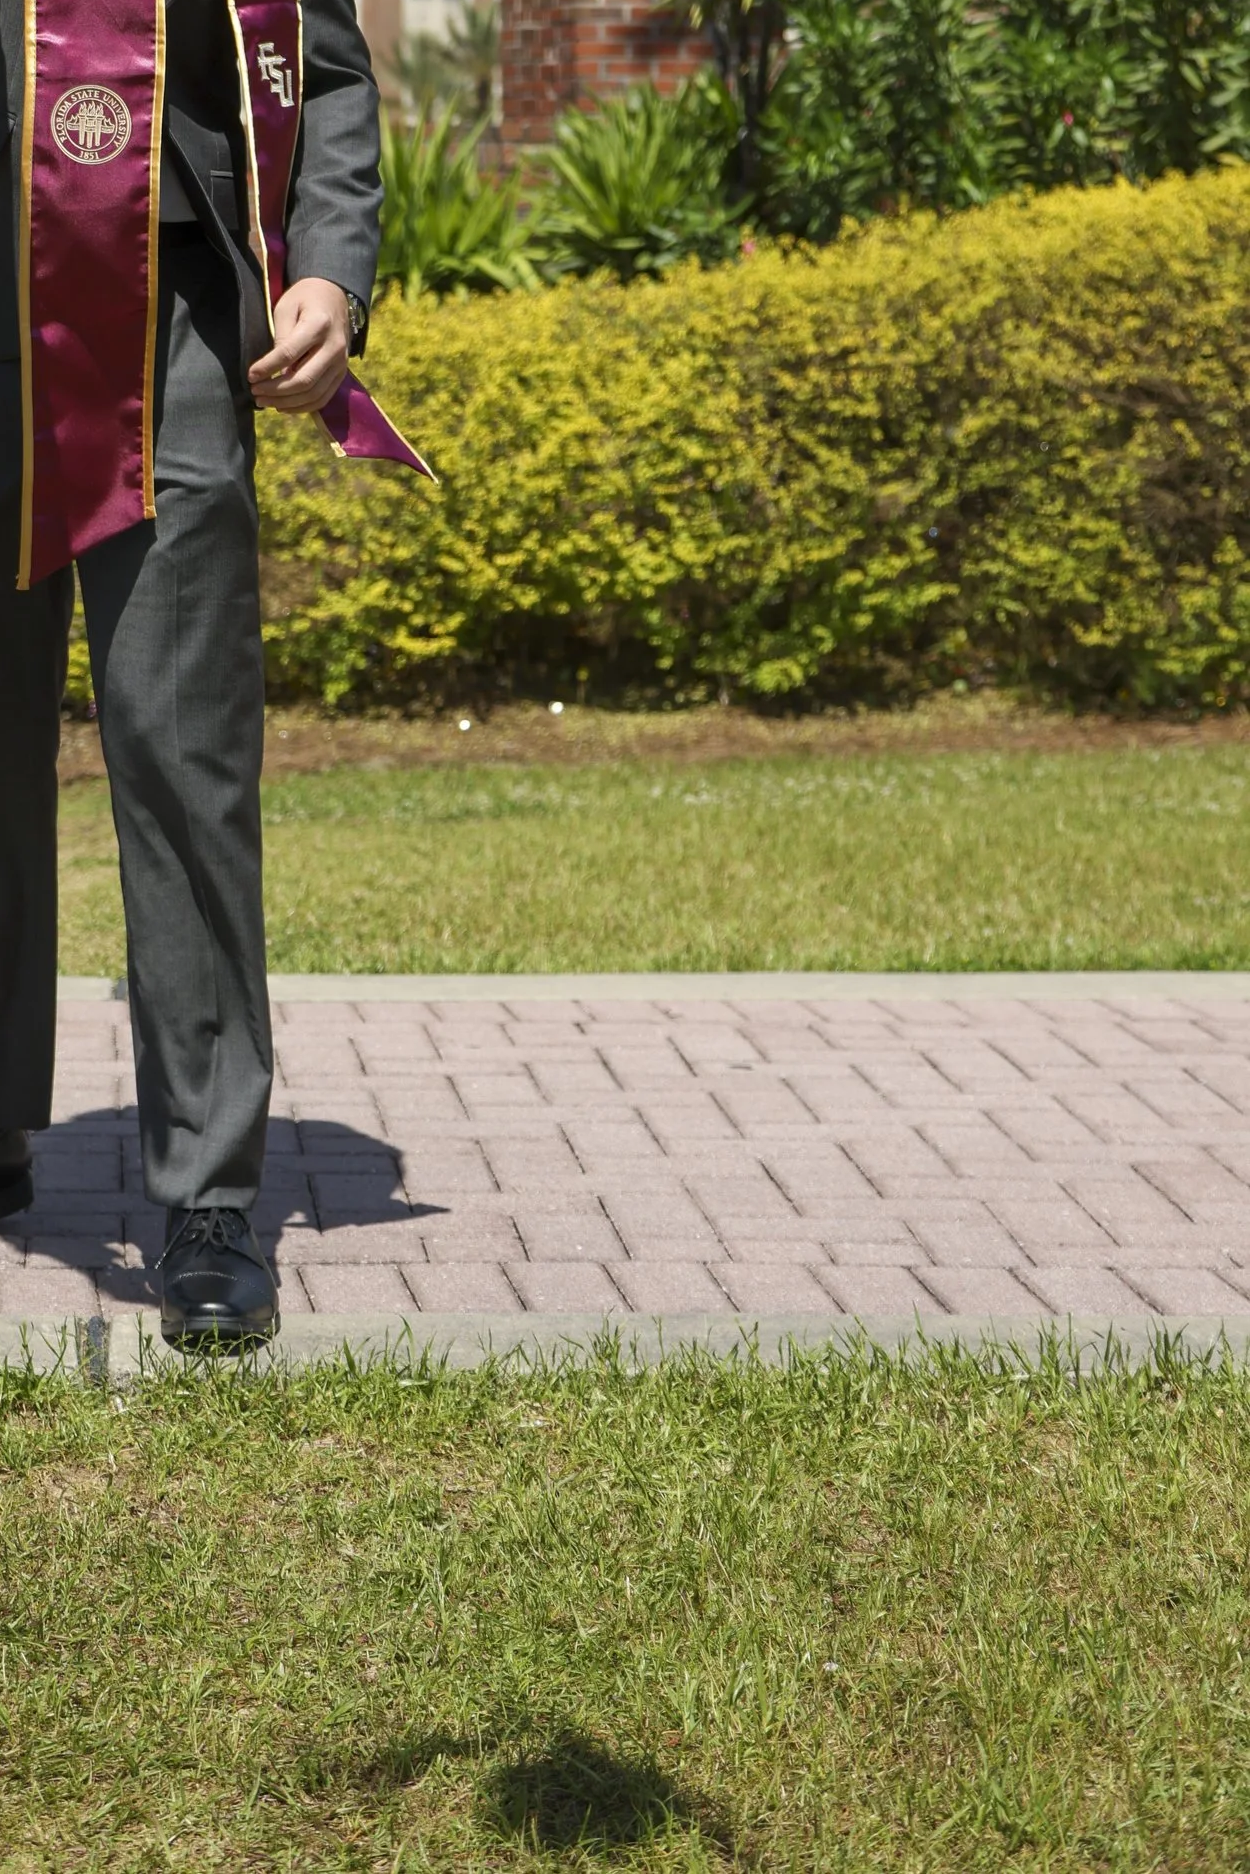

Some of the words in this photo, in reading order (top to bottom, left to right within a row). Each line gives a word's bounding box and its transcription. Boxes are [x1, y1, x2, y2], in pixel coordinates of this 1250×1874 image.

[256, 42, 295, 108] FSU
[54, 100, 72, 146] FLORIDA
[70, 89, 100, 103] STATE
[103, 93, 127, 149] UNIVERSITY
[79, 151, 100, 161] 1851
